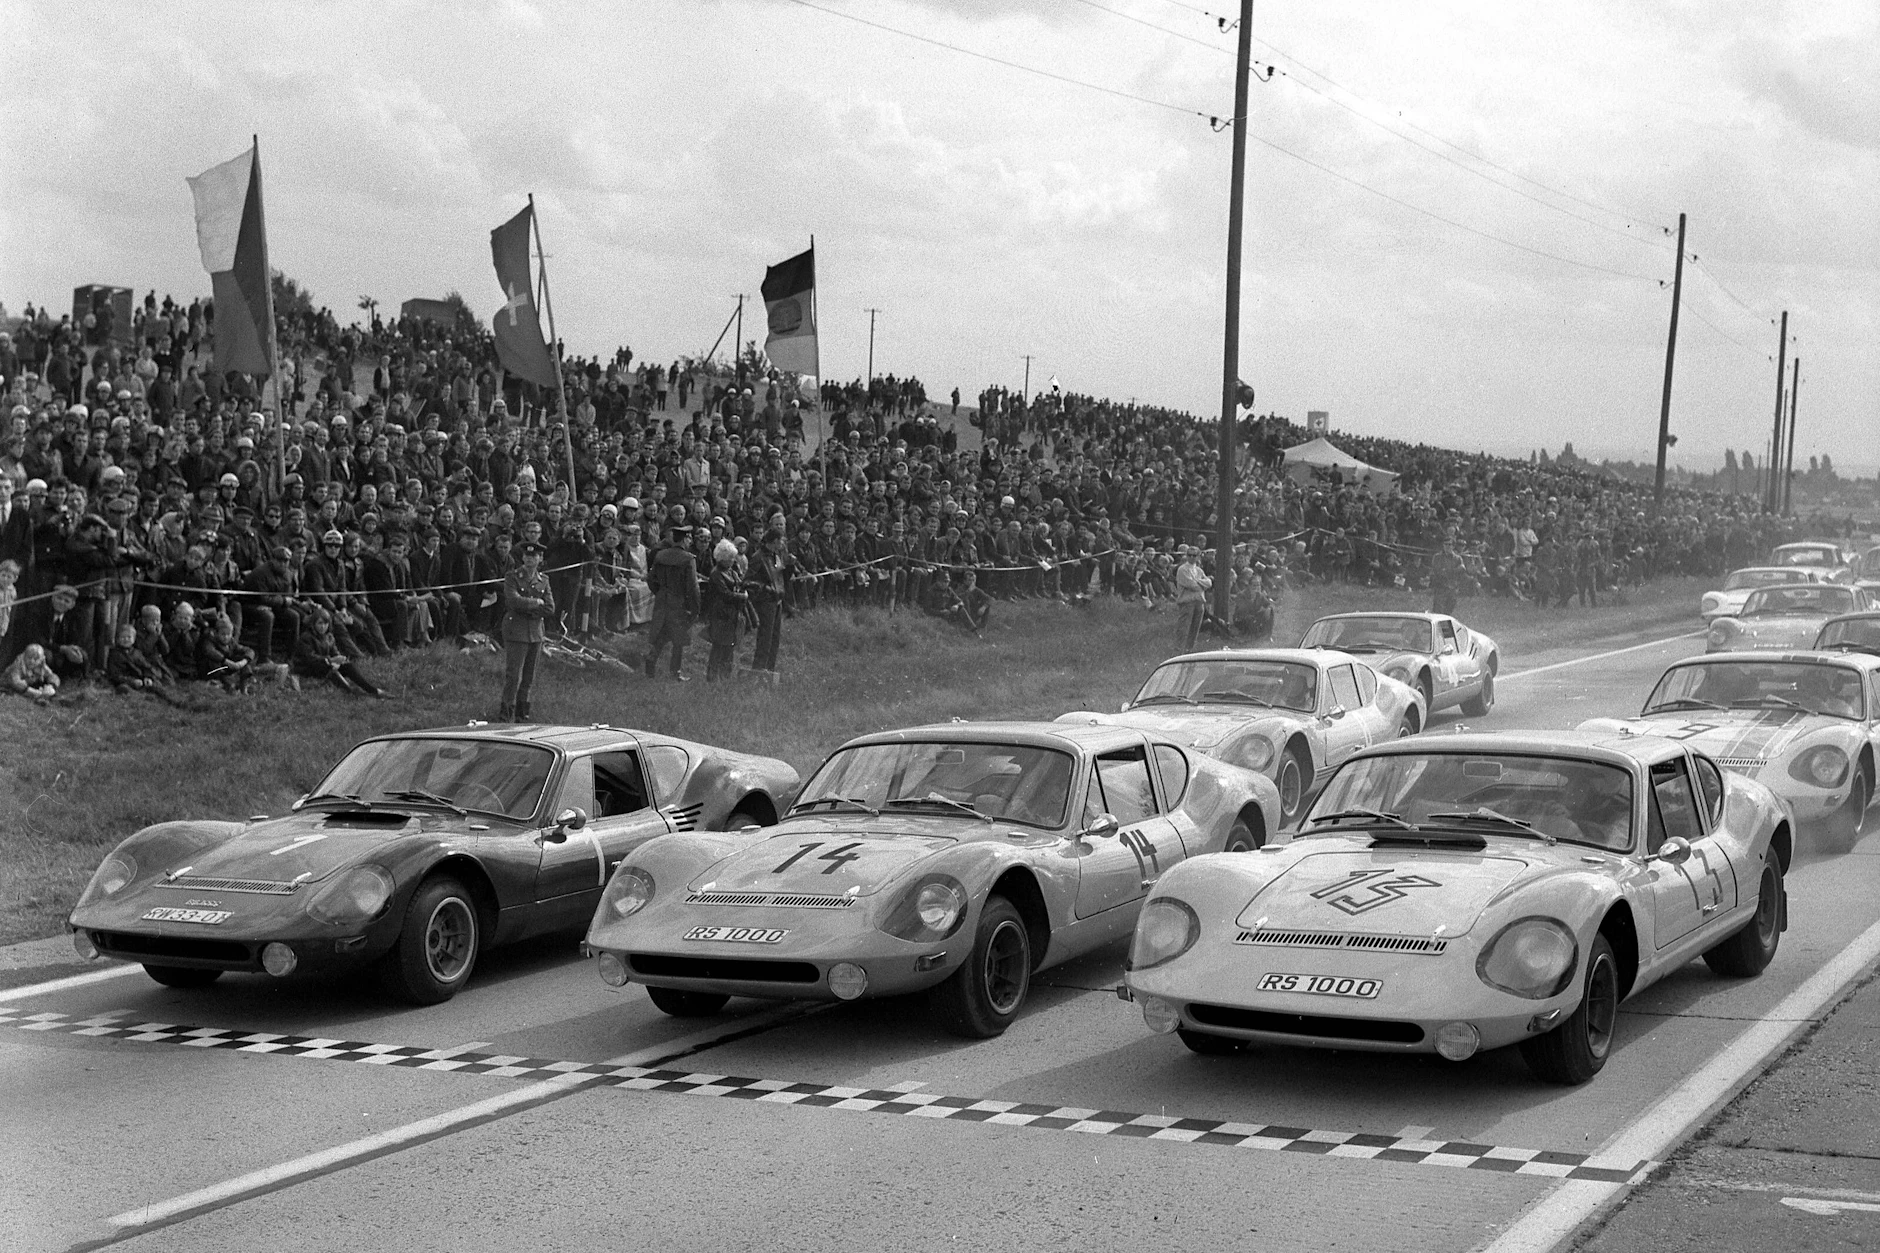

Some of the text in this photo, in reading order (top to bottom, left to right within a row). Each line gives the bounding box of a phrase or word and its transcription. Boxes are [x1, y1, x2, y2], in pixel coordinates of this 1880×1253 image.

[771, 842, 865, 875] 14
[1119, 829, 1160, 880] 14
[688, 926, 786, 942] RS 1000
[1262, 974, 1377, 996] RS 1000
